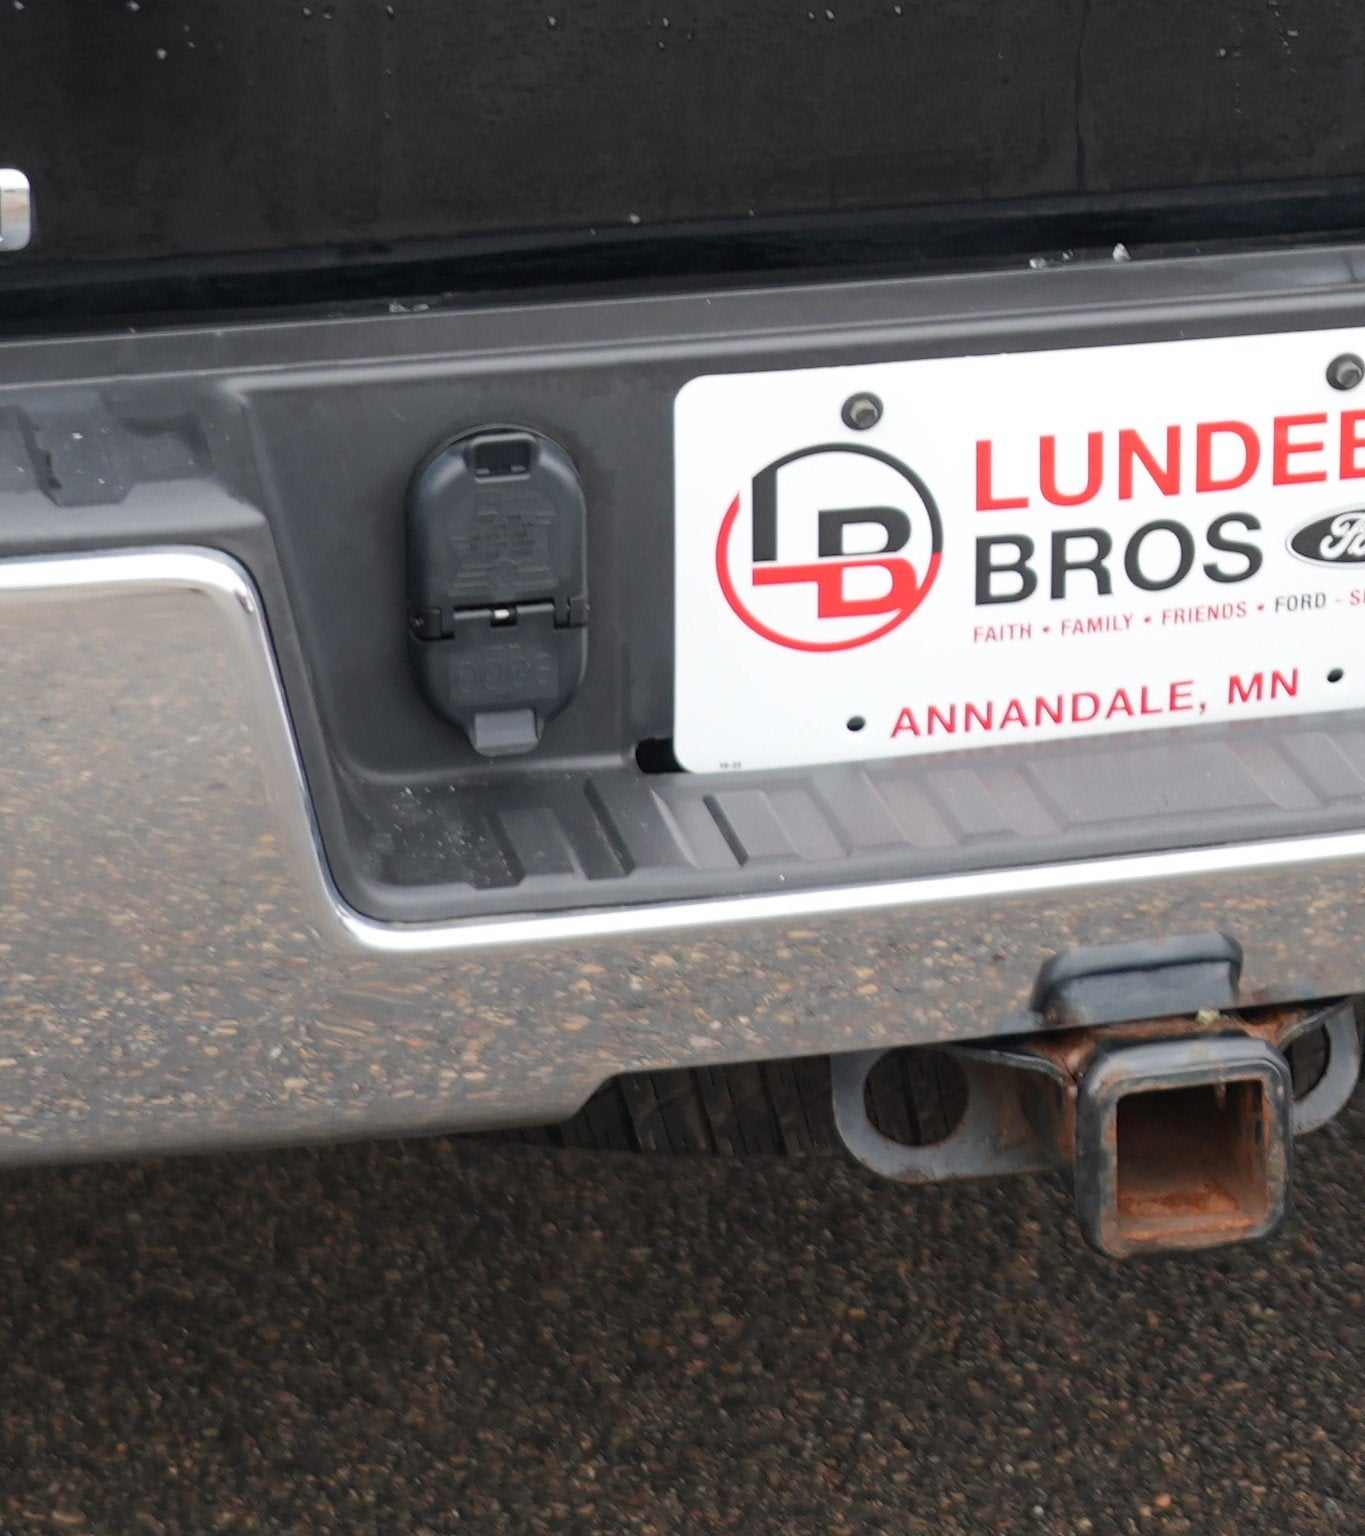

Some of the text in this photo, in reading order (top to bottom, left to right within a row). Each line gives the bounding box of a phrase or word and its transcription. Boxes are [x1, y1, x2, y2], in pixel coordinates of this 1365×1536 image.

[975, 510, 1264, 606] BROS
[973, 621, 1033, 643] FAITH
[1061, 613, 1134, 636] FAMILY
[1161, 601, 1248, 626] FRIENDS
[1274, 592, 1327, 613] FORD
[890, 667, 1300, 739] ANNANDALE, MN
